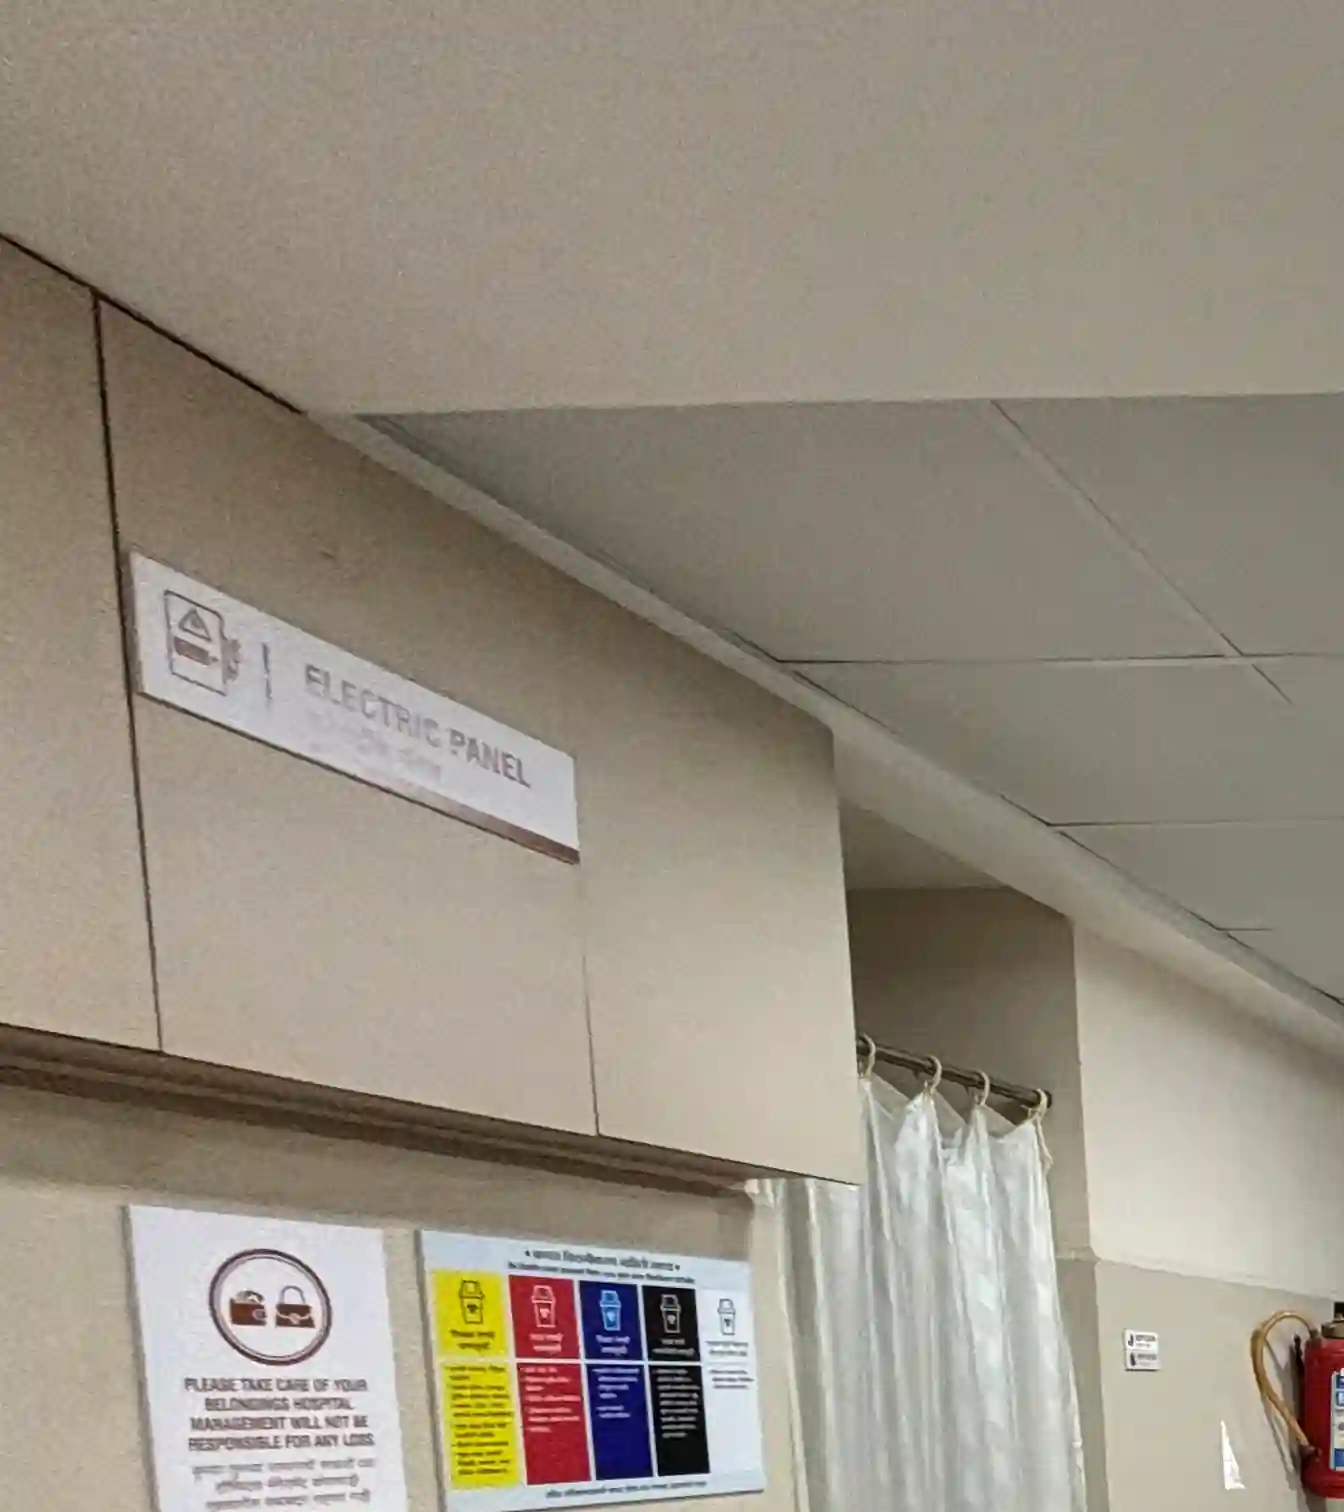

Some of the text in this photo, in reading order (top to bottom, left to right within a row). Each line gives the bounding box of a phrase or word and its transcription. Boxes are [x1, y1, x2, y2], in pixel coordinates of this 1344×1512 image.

[305, 664, 442, 748] ELECTRIC
[447, 727, 531, 788] PANEL
[184, 1378, 368, 1392] PLEASE TAKE CARE OF YOUR
[294, 1397, 355, 1410] HOSPITAL
[190, 1417, 285, 1431] MANAGEMENT
[290, 1416, 321, 1429] WILL
[325, 1416, 349, 1428] NOT
[285, 1435, 311, 1448] FOR
[315, 1434, 338, 1447] ANY
